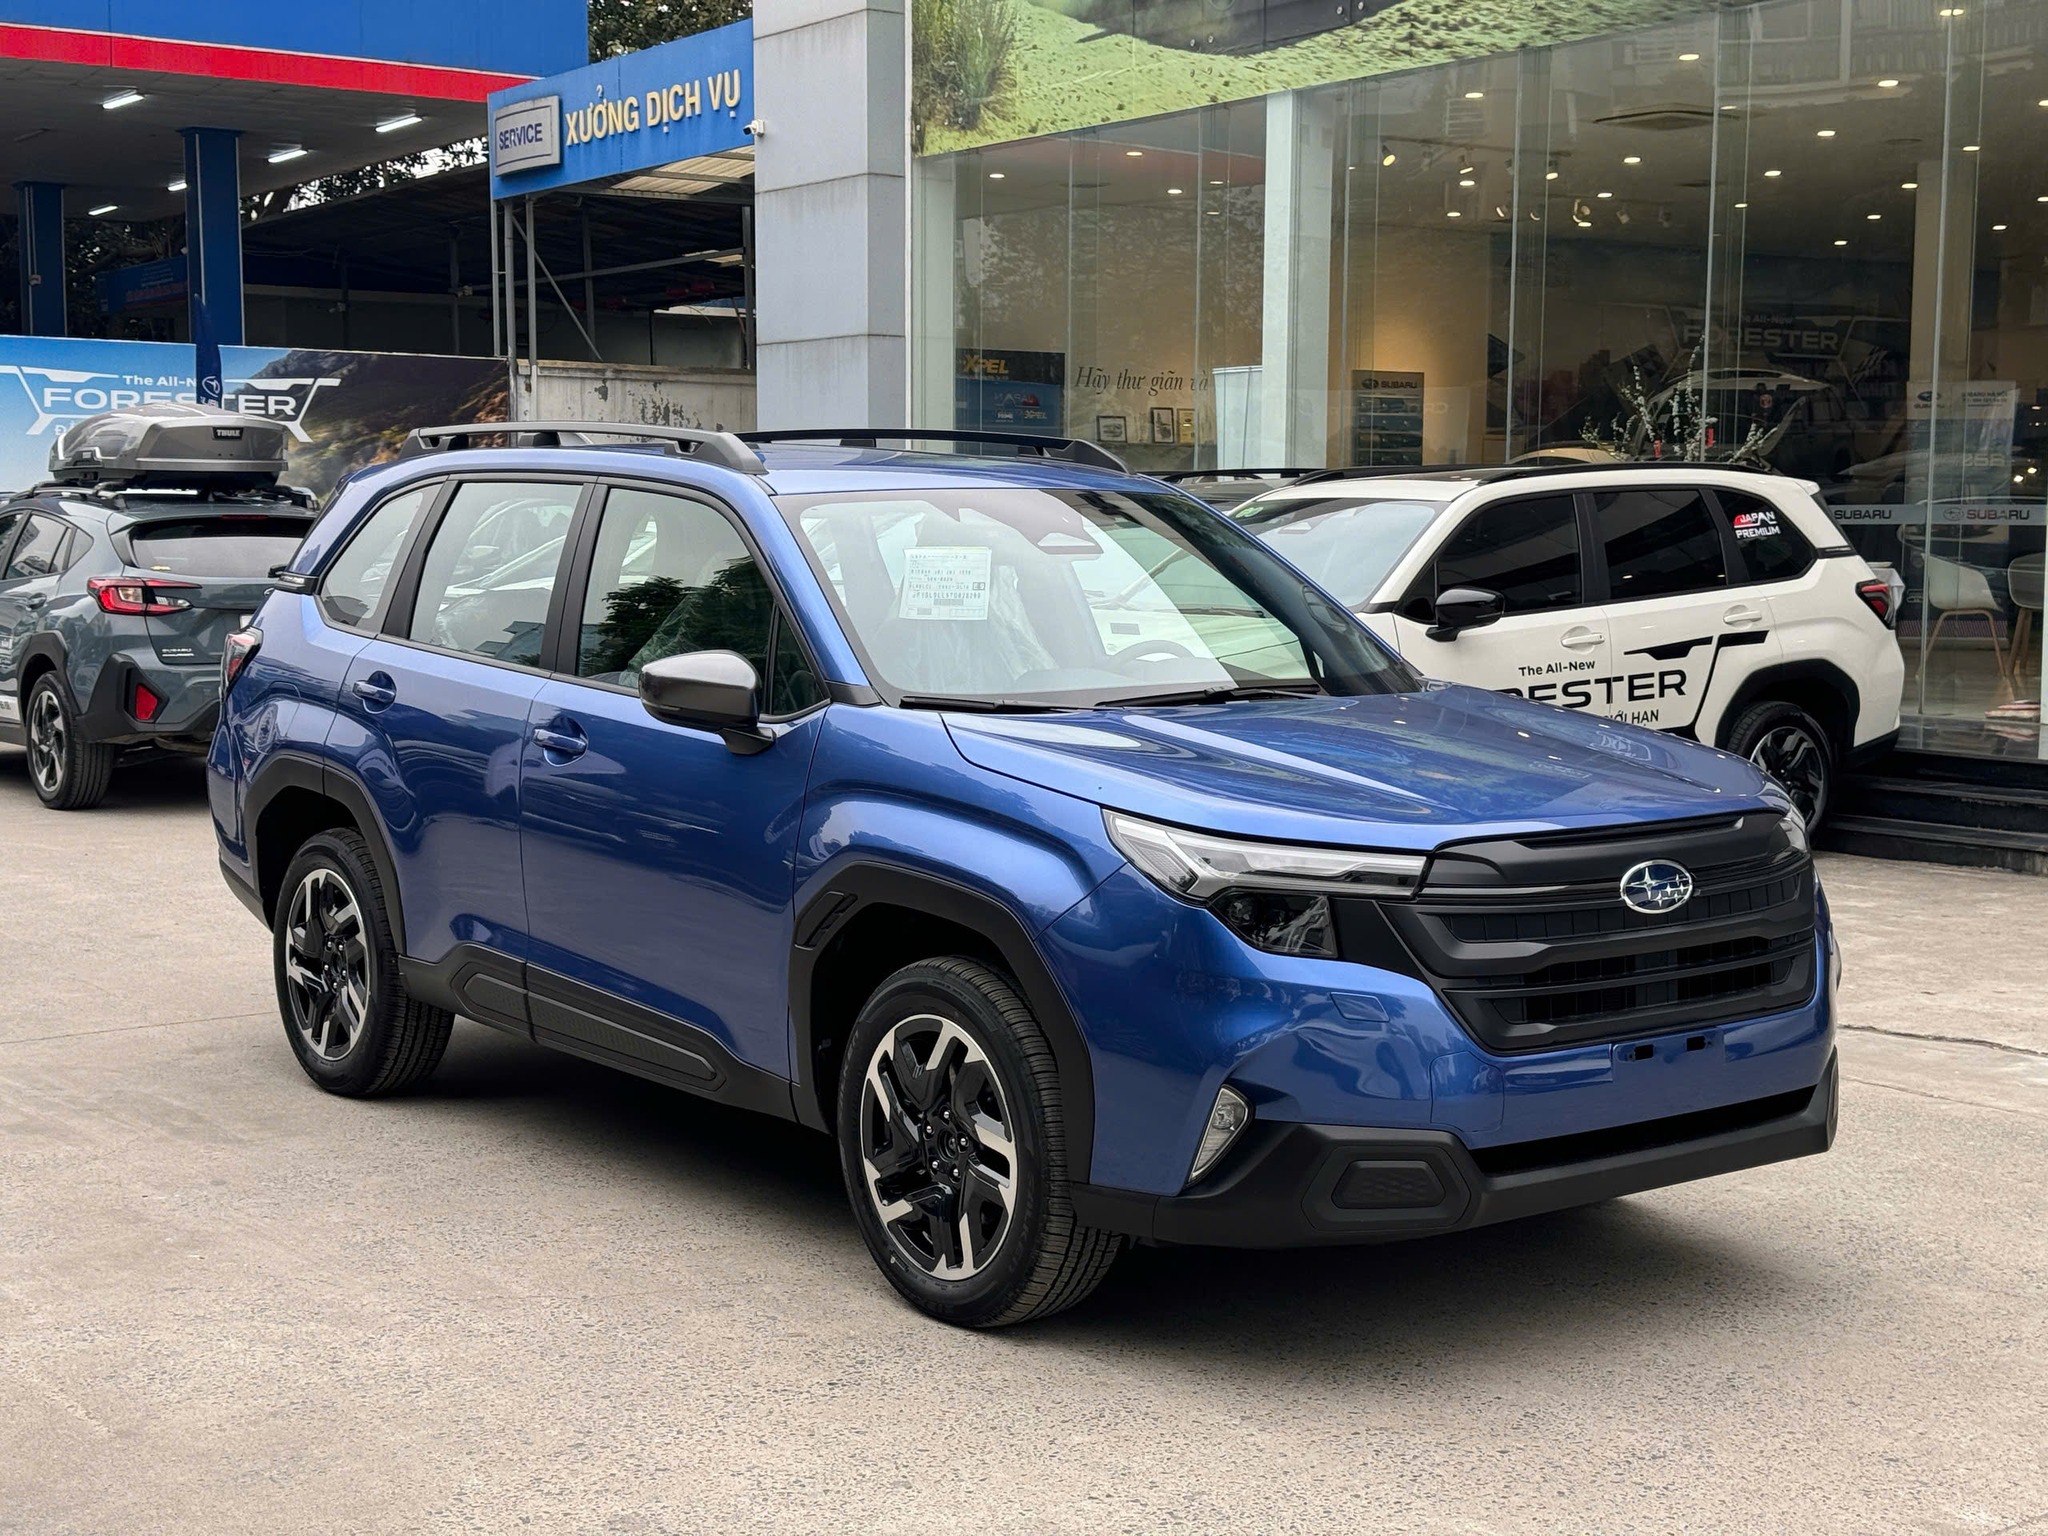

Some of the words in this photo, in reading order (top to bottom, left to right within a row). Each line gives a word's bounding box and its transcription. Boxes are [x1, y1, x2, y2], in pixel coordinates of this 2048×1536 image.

[566, 85, 640, 147] XƯỞNG
[646, 80, 702, 134] DỊCH
[707, 69, 741, 119] VỤ
[498, 122, 543, 150] SERVICE
[963, 354, 1009, 375] XPEL
[122, 374, 154, 386] The
[156, 375, 197, 387] All-N
[1116, 368, 1146, 390] thư
[1147, 370, 1183, 397] giãn
[1381, 380, 1418, 389] SUBARU
[216, 429, 240, 437] THULE
[1739, 511, 1776, 525] JAPAN
[1834, 509, 1892, 520] SUBARU
[1966, 509, 2031, 520] SUBARU
[1735, 525, 1781, 539] PREMIUM
[1518, 665, 1543, 677] The
[1545, 661, 1596, 675] All-New
[1631, 709, 1660, 727] HẠN
